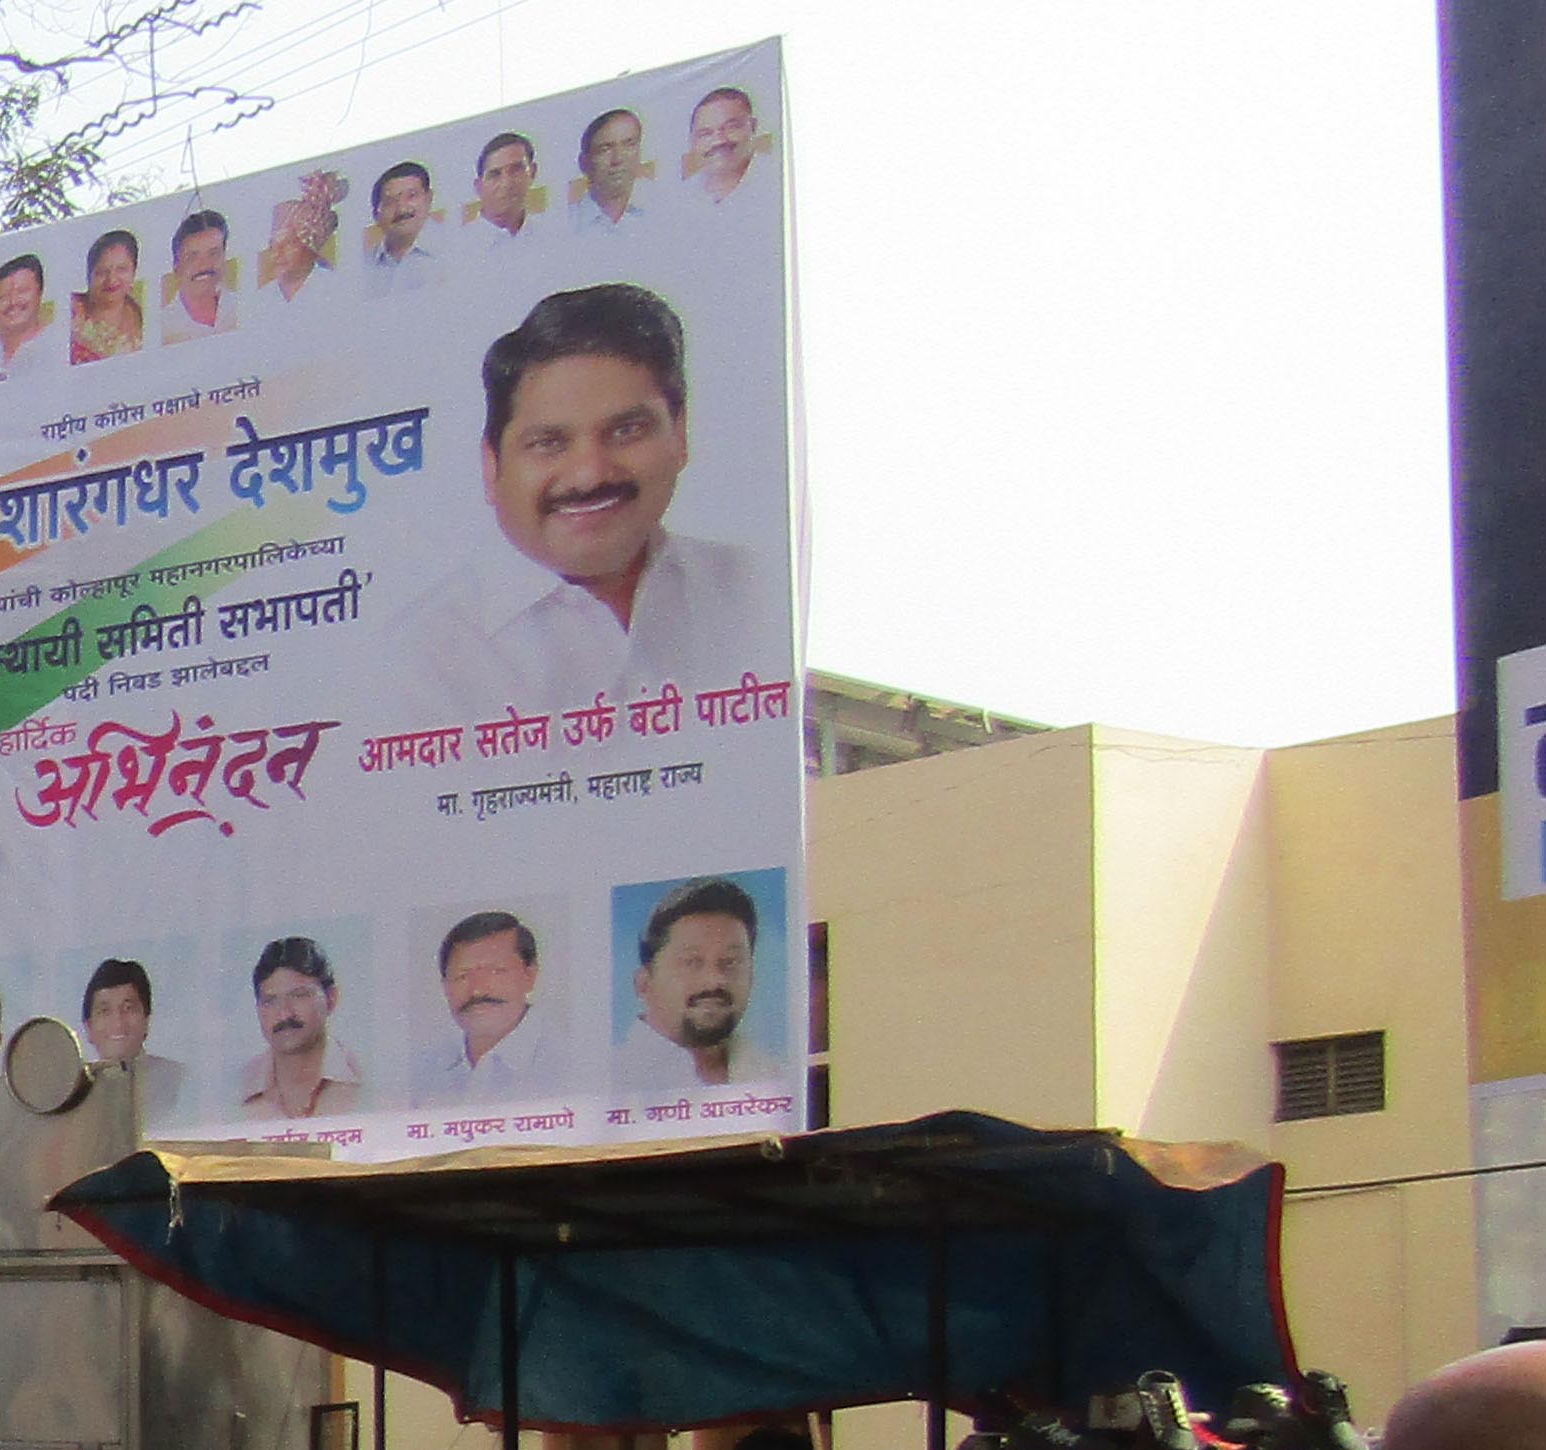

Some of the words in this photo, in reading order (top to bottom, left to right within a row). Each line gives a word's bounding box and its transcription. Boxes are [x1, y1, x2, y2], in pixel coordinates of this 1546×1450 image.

[41, 413, 88, 443] राष्ट्रीय
[153, 388, 201, 418] पक्षाचे
[208, 376, 261, 404] गटनेते
[225, 406, 430, 515] देशमुख
[50, 572, 142, 608] कोल्हापूर
[148, 536, 345, 588] महानगरपालिकेच्या
[96, 595, 205, 660] समिती
[63, 677, 99, 702] पदी
[109, 669, 162, 695] निवड
[171, 652, 271, 686] झालेबद्दल
[359, 727, 464, 772] आमदार
[474, 706, 550, 758] सतेज
[562, 692, 617, 748] उर्फ
[629, 684, 683, 736] बंटी
[695, 671, 791, 727] पाटील
[15, 709, 341, 837] अभिनंदन
[437, 792, 463, 817] मा.
[587, 768, 653, 801] महाराष्ट्र
[660, 762, 704, 788] राज्य
[407, 1123, 434, 1139] मा.
[443, 1118, 505, 1143] मधुकर
[512, 1107, 575, 1132] रामाणे
[607, 1108, 636, 1124] मा.
[699, 1093, 793, 1118] आजरेकर
